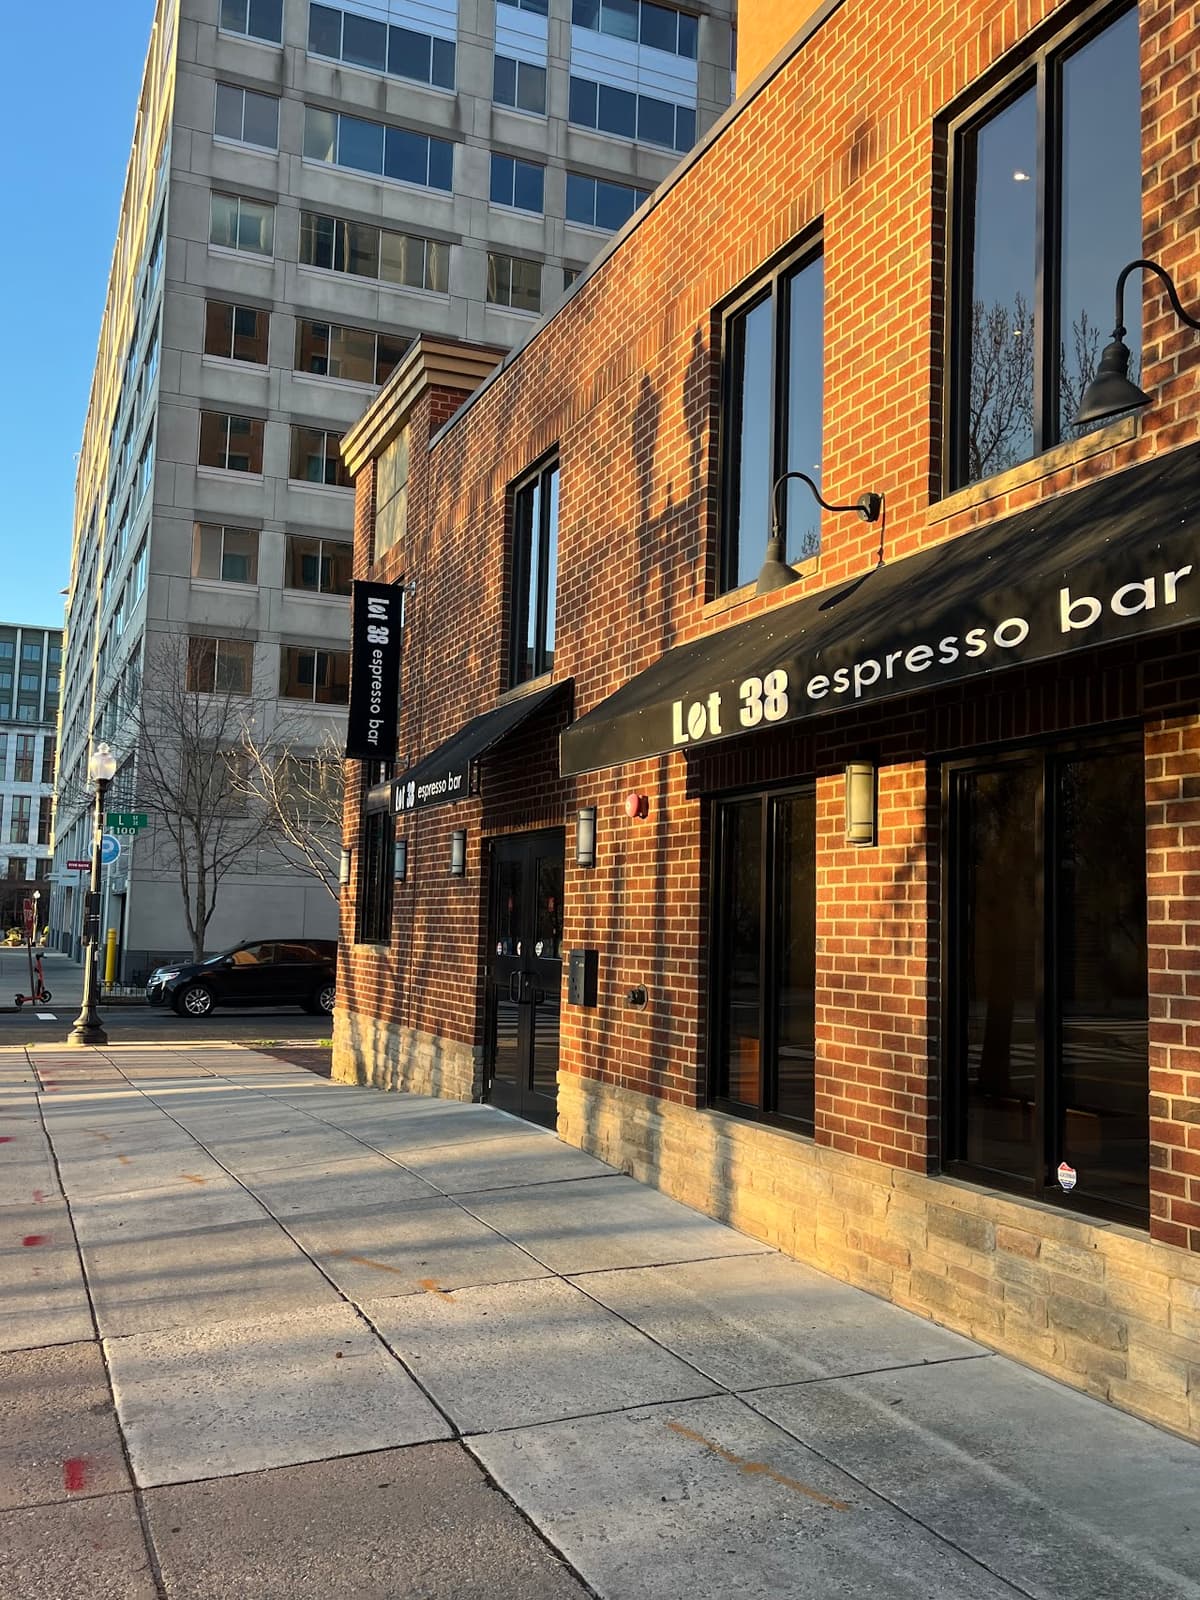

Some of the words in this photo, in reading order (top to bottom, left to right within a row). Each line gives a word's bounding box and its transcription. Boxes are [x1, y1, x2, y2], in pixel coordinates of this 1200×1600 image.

[367, 597, 390, 620] Lot
[367, 625, 390, 645] 38
[672, 697, 722, 745] Lot
[739, 669, 789, 727] 38
[807, 617, 1030, 698] espresso
[1060, 564, 1193, 633] bar
[368, 649, 383, 714] espresso
[367, 719, 385, 746] bar
[417, 779, 447, 802] espresso
[448, 771, 462, 791] bar
[116, 827, 136, 835] 100
